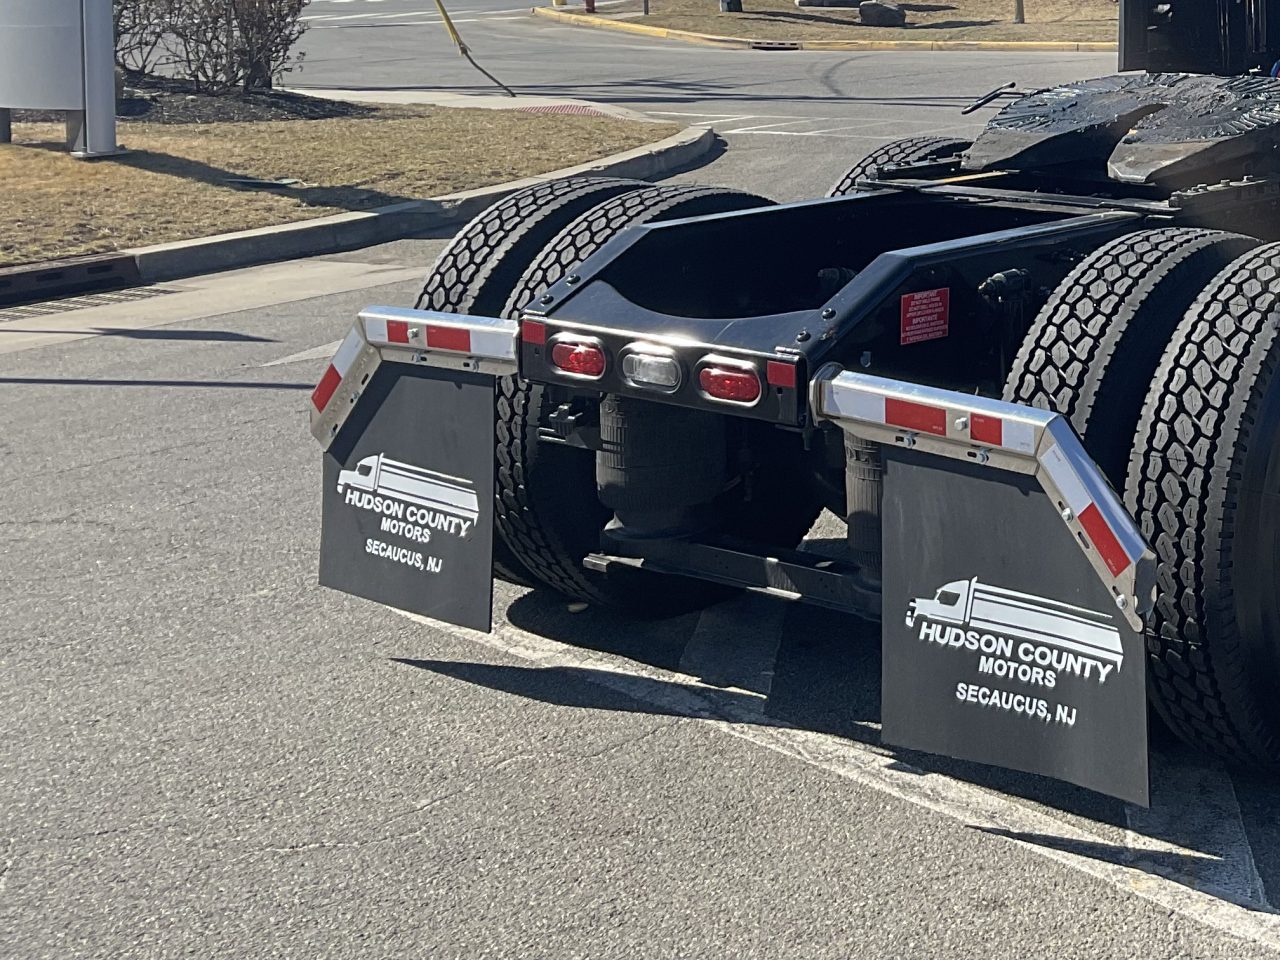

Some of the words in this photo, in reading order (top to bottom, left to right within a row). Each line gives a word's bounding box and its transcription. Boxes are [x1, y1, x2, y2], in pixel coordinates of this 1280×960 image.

[344, 489, 405, 518] HUDSON
[406, 505, 472, 537] COUNTY
[380, 516, 432, 544] MOTORS
[365, 538, 425, 571] SECAUCUS,
[426, 556, 443, 573] NJ
[918, 622, 1014, 658] HUDSON
[1017, 642, 1114, 683] COUNTY
[978, 655, 1057, 688] MOTORS
[955, 683, 1052, 721] SECAUCUS,
[1055, 703, 1077, 725] NJ
